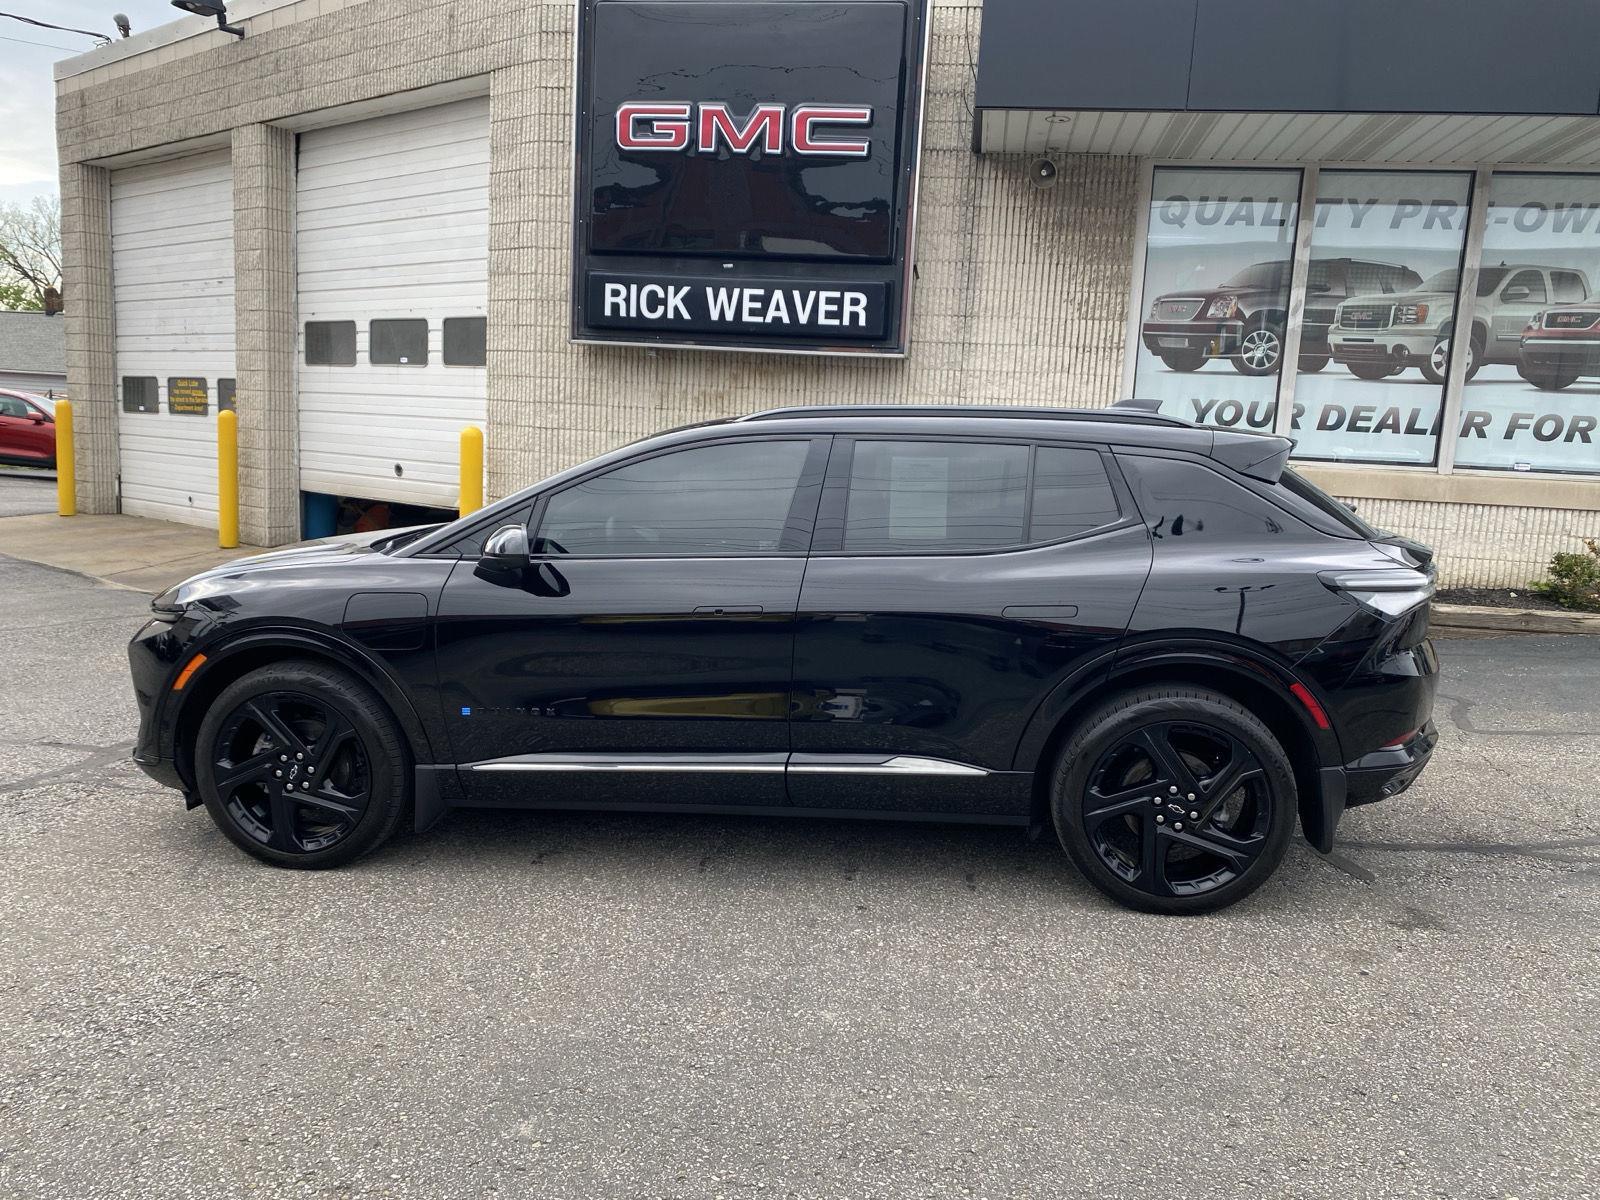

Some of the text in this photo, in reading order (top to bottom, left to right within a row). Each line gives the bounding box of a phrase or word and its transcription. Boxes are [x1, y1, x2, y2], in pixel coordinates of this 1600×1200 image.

[616, 103, 873, 156] GMC
[1389, 198, 1600, 235] PR-OW
[604, 283, 868, 326] RICK WEAVER
[1503, 412, 1598, 444] FOR
